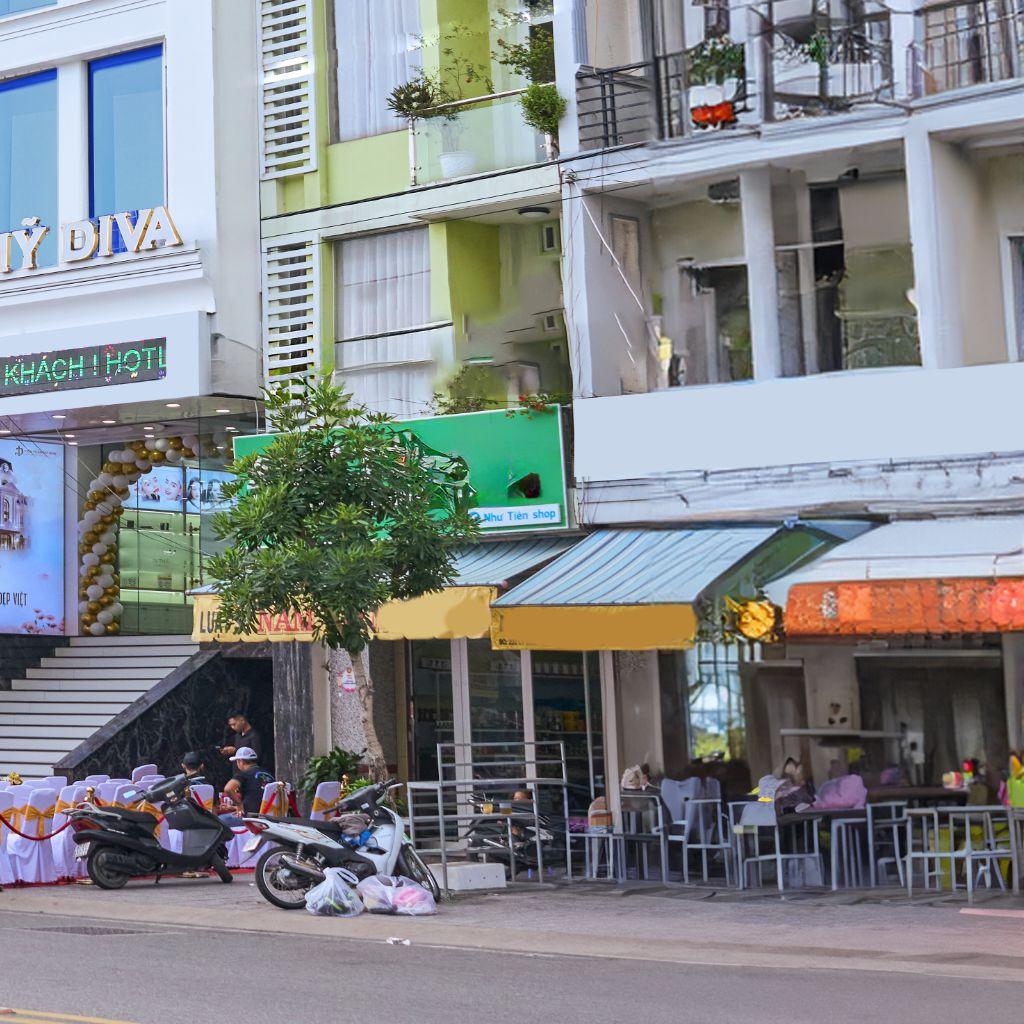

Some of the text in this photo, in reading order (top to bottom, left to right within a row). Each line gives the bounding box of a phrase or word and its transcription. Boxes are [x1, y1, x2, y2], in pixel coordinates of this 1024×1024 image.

[61, 205, 184, 263] DIVA
[5, 355, 83, 386] KHÁCH
[532, 509, 556, 520] shop
